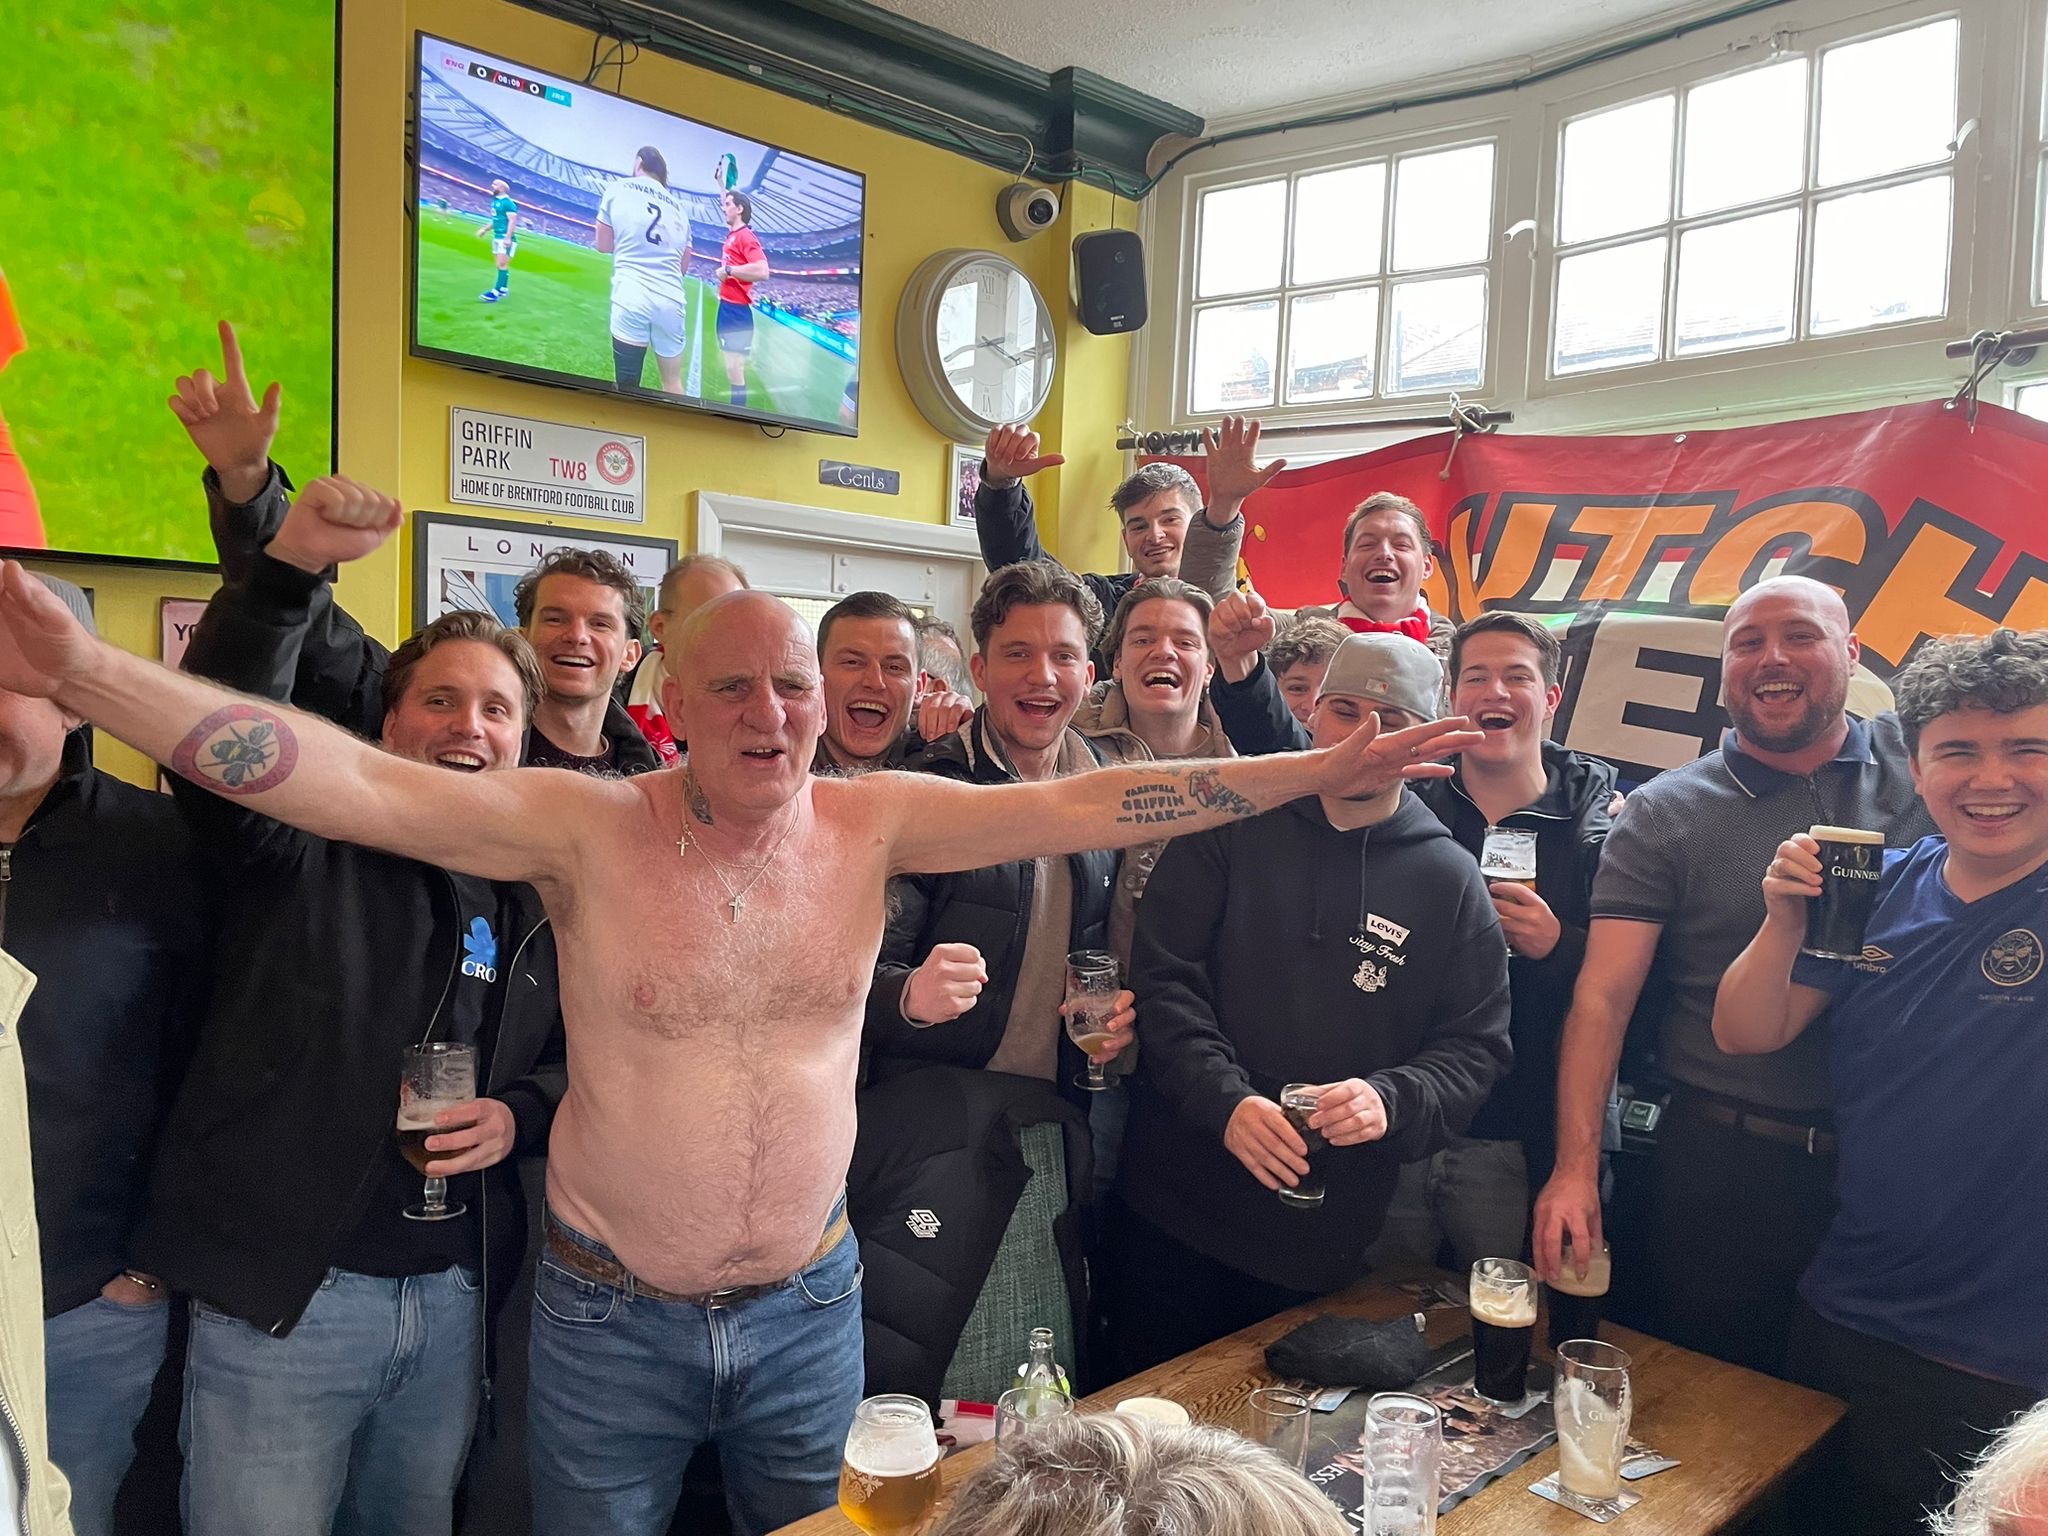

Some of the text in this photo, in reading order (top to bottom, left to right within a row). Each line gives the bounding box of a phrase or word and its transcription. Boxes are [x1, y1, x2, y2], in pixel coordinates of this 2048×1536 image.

[476, 67, 487, 78] 0
[529, 83, 540, 94] 0
[645, 202, 663, 246] 2
[462, 420, 532, 449] GRIFFIN
[462, 446, 511, 470] PARK
[549, 458, 587, 481] TW8
[838, 465, 885, 490] Gents
[461, 478, 635, 514] HOME OF BRENTFORD FOOTBALL CLUB
[468, 536, 634, 567] LONN
[1122, 795, 1185, 811] GRIFFIN
[1134, 809, 1178, 823] PARK
[1832, 865, 1880, 880] GUINNESS
[1349, 934, 1406, 966] Stay Fresh
[1853, 961, 1887, 974] umbro
